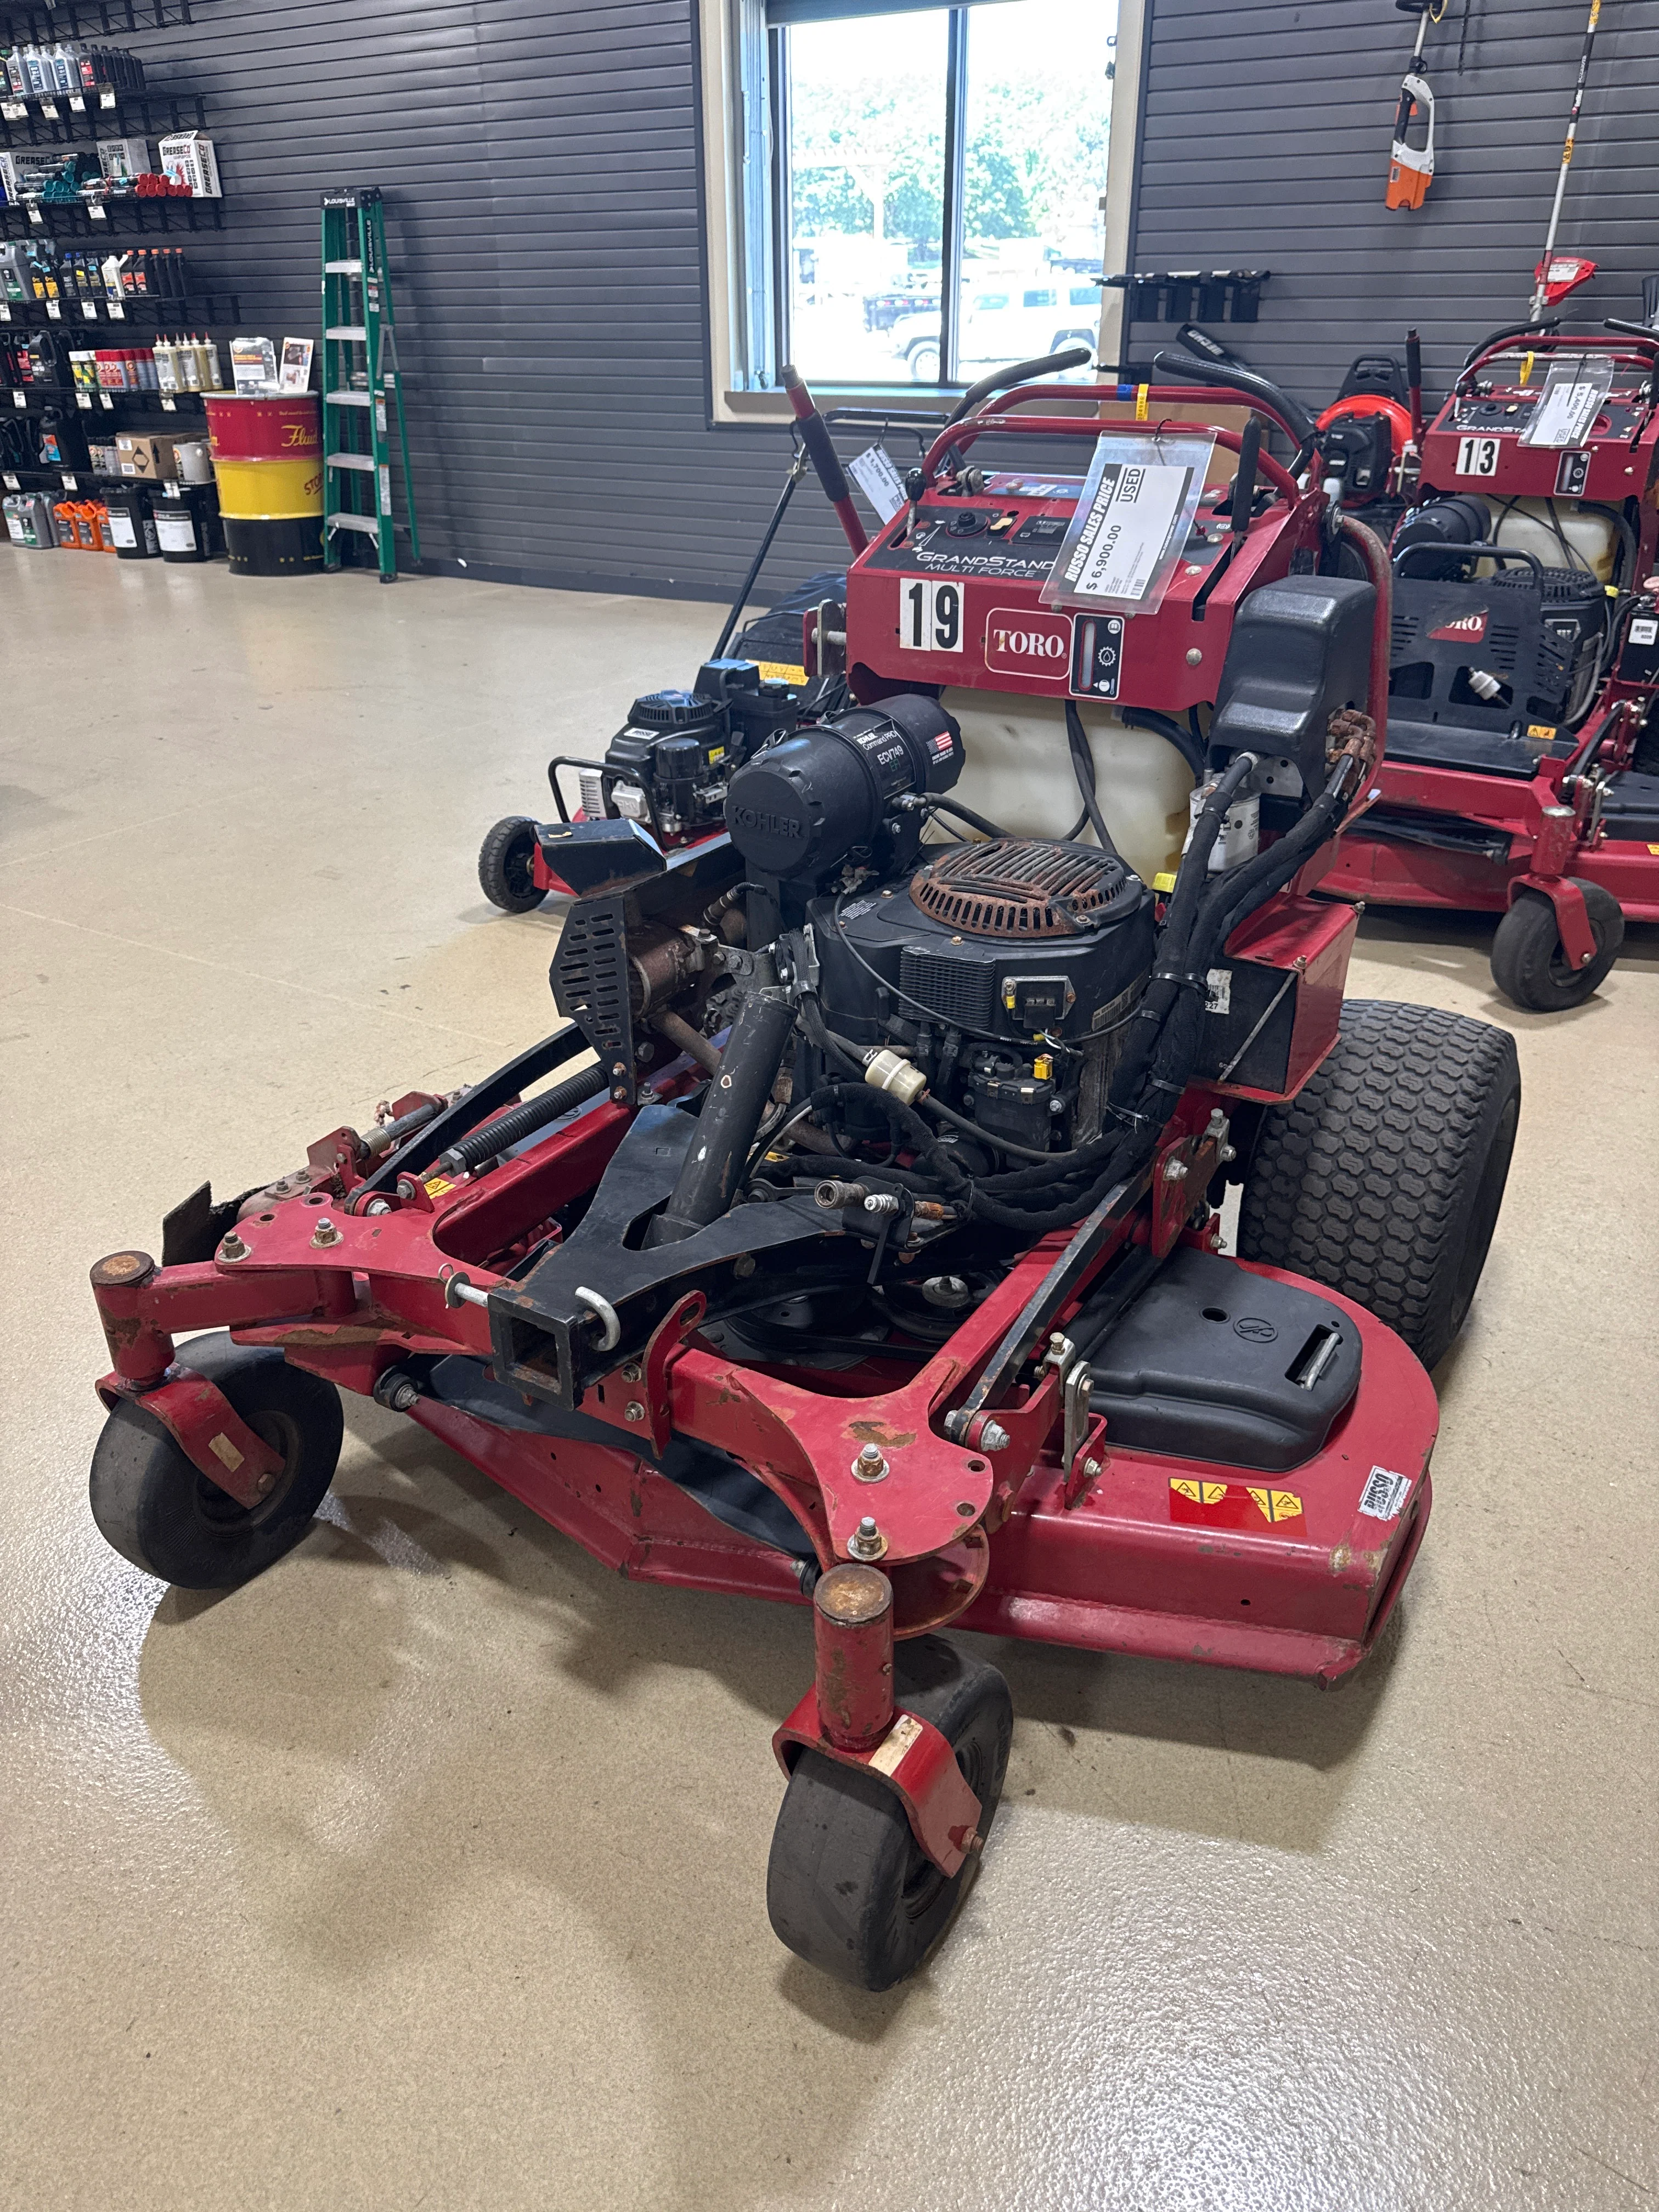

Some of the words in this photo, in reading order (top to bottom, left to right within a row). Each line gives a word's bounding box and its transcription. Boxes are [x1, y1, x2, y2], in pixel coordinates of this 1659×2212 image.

[15, 155, 53, 165] GREASEC
[1464, 439, 1495, 473] 13
[1120, 469, 1141, 503] USED
[1065, 543, 1089, 582] RUSSO
[1082, 511, 1103, 545] SALES
[1094, 477, 1115, 515] PRICE
[1091, 525, 1121, 578] 6,900.00
[925, 563, 973, 573] MULTI
[978, 567, 1036, 578] FORCE
[1086, 582, 1098, 591] $
[909, 583, 960, 650] 19
[993, 629, 1065, 659] TORO
[862, 735, 887, 751] Command
[884, 730, 897, 740] PRO
[877, 744, 904, 765] ECV749
[732, 805, 801, 839] KOHLER
